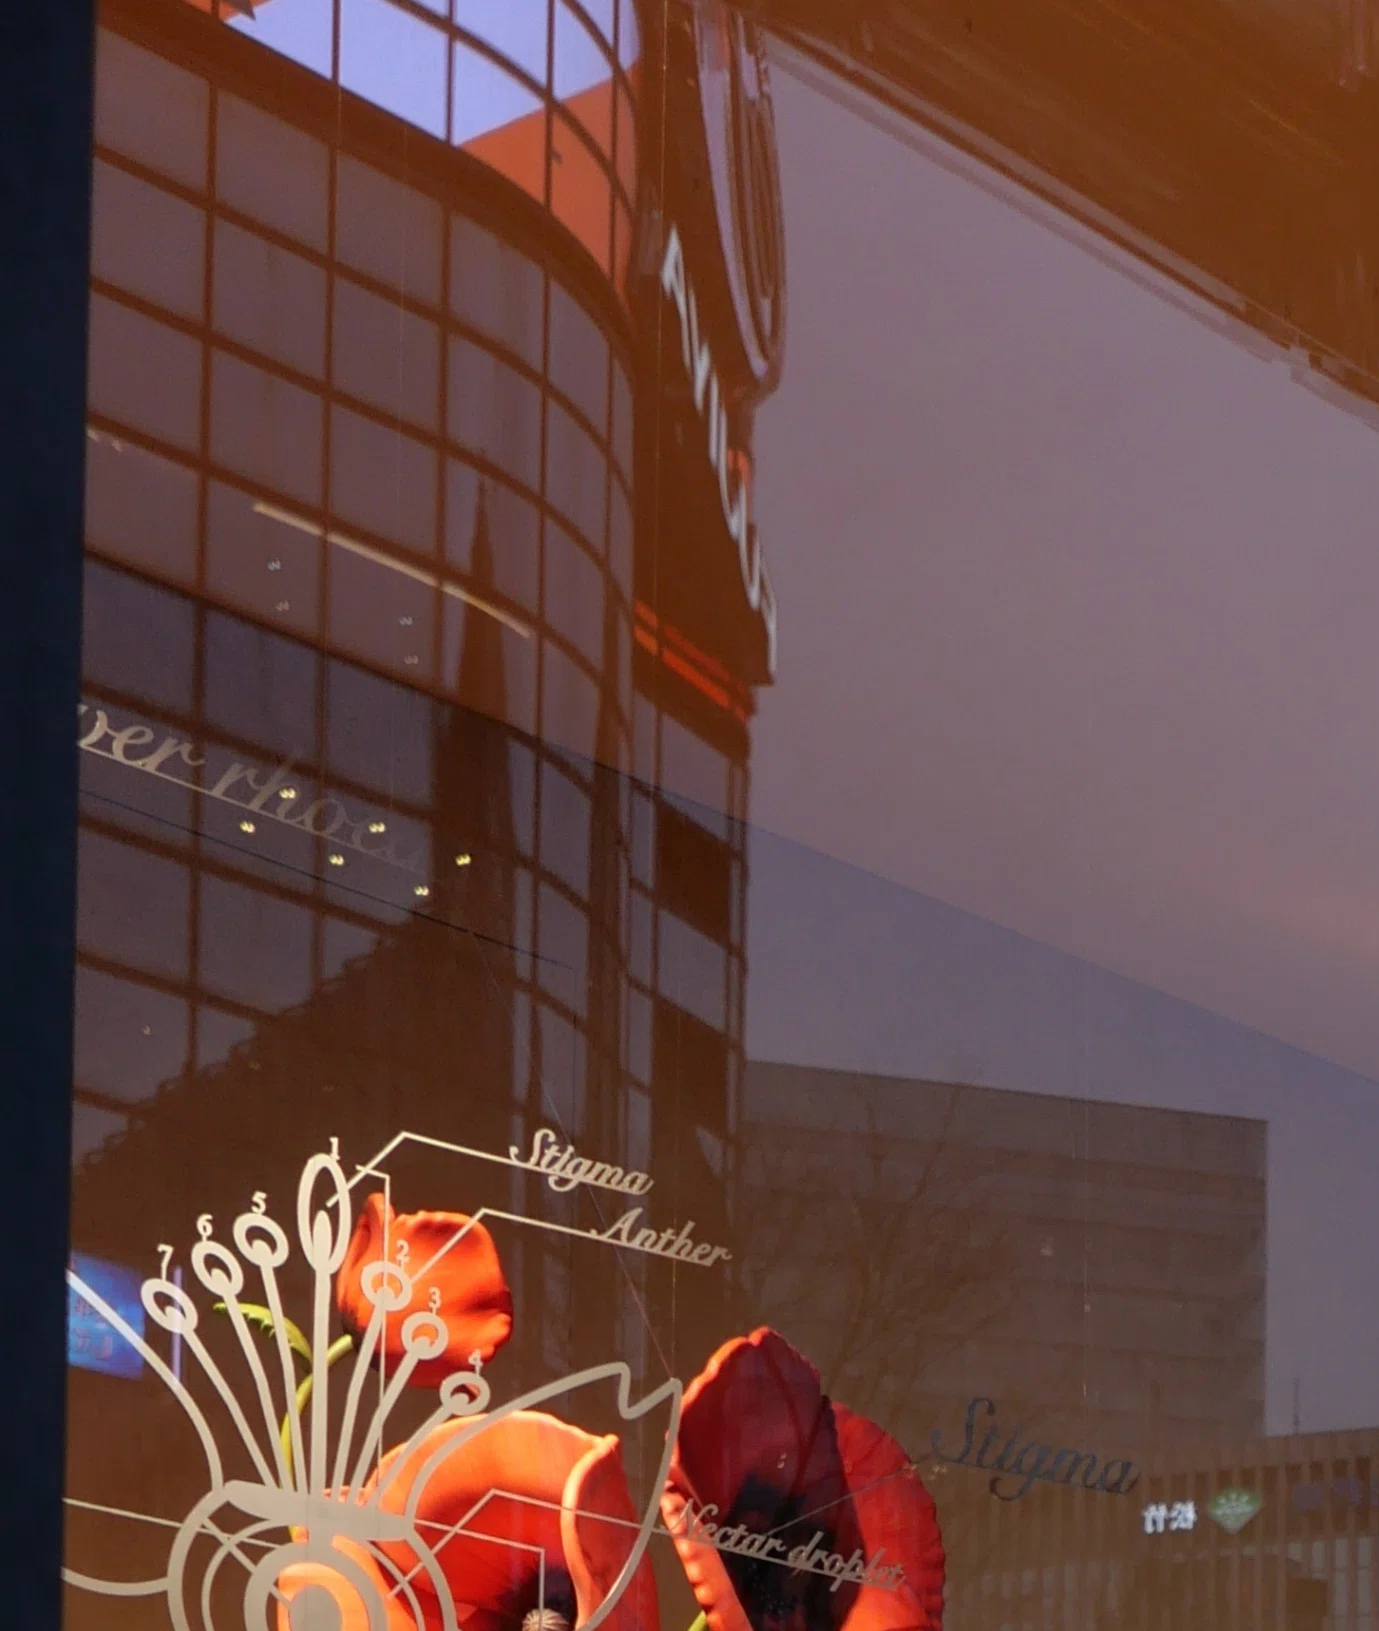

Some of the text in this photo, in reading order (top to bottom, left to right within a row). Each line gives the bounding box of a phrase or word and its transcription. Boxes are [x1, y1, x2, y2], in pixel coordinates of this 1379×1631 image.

[508, 1128, 655, 1194] Stigma
[590, 1207, 733, 1268] Anther
[930, 1397, 1143, 1501] Stigma
[661, 1498, 786, 1557] Nectar
